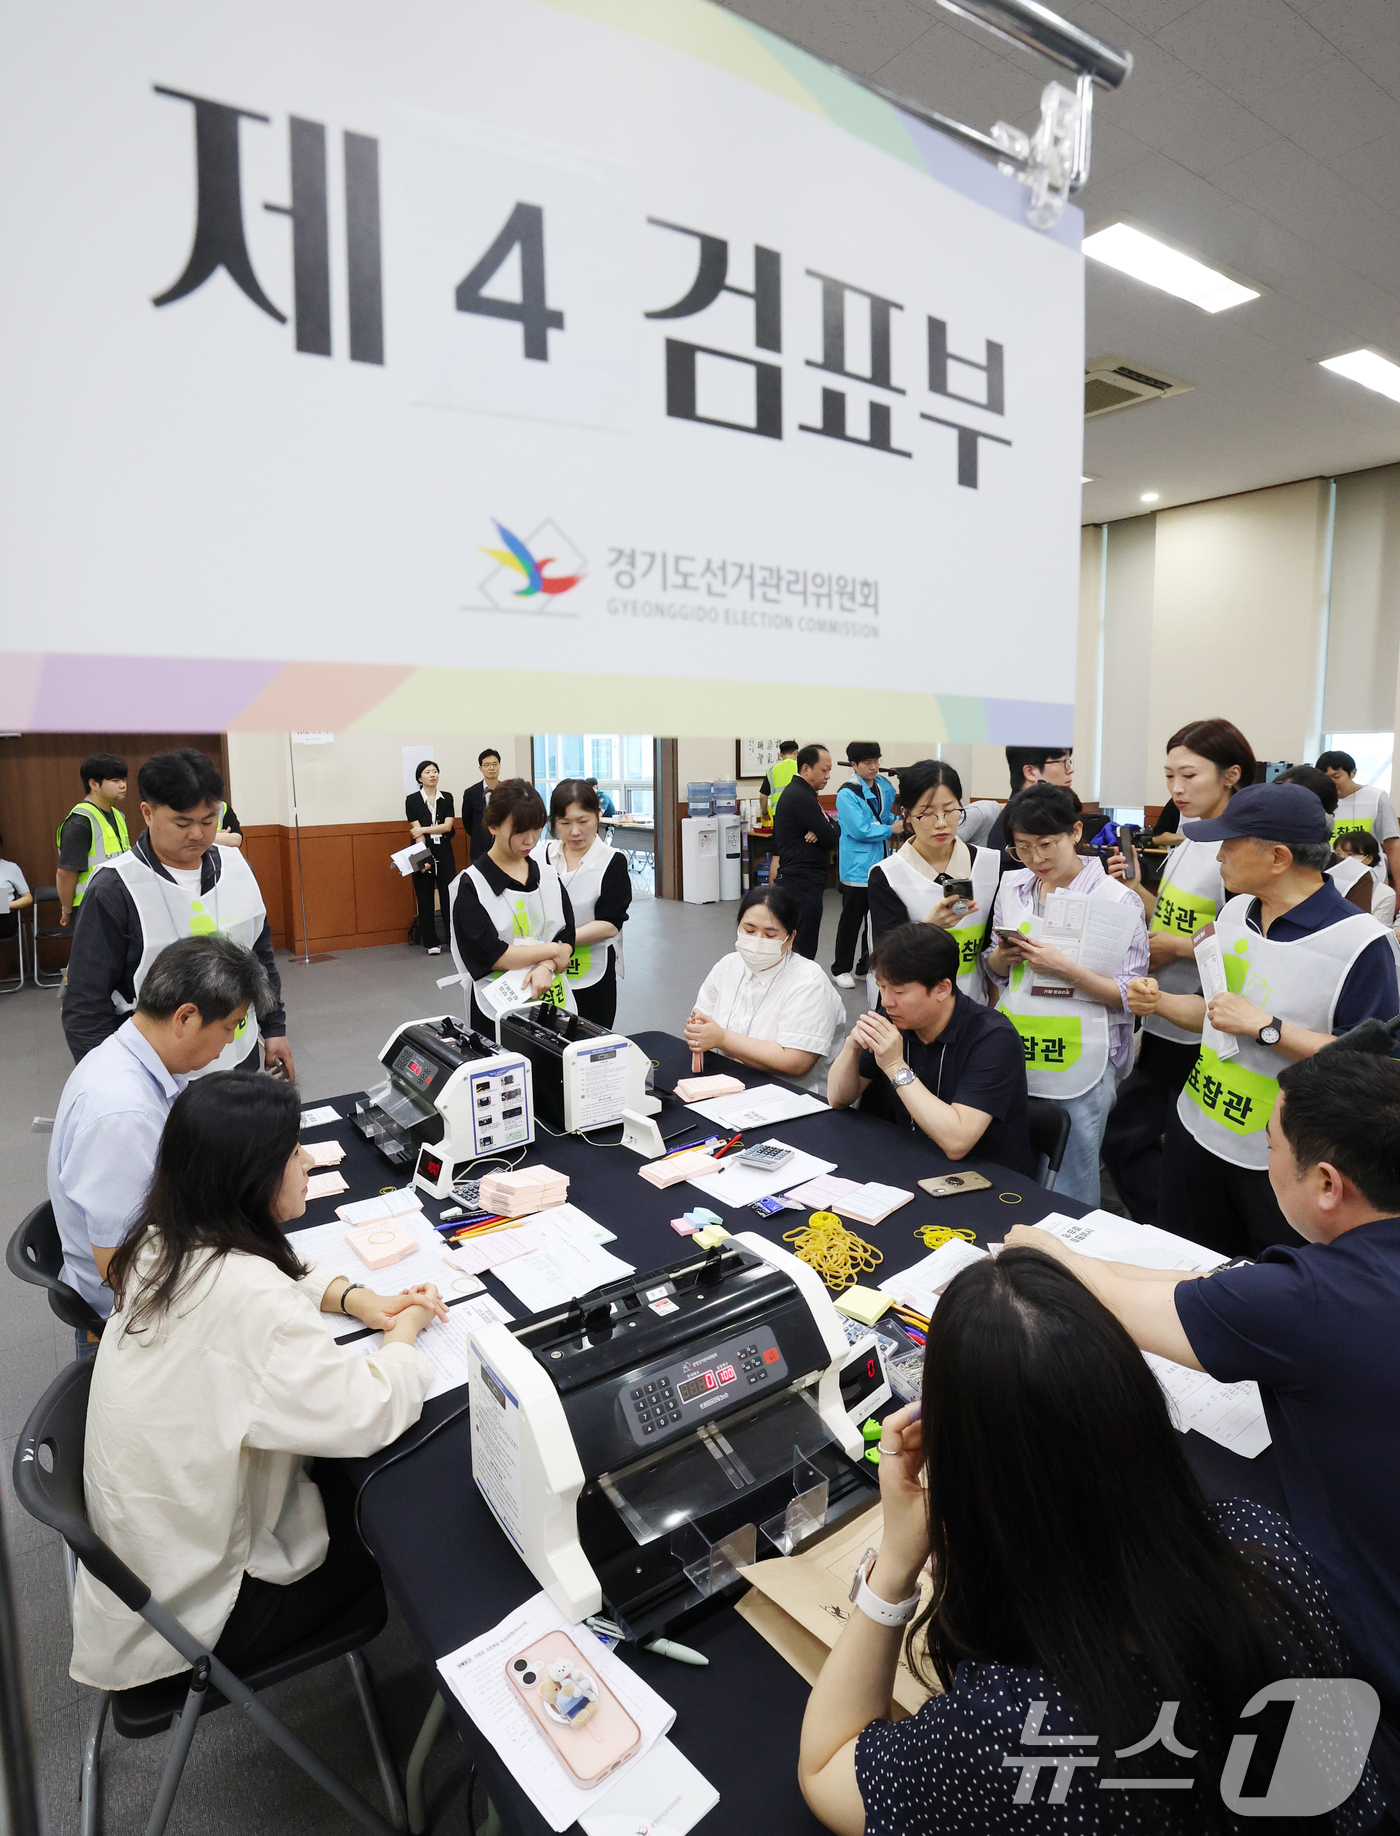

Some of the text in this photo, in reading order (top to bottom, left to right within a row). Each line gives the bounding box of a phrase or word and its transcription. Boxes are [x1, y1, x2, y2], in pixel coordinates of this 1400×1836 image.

[151, 82, 1013, 491] 제 4 검표부
[606, 546, 880, 616] 경기도선거관리위원회
[606, 597, 881, 640] GYEONGGIDO ELECTION COMMISSION
[427, 1161, 440, 1176] 100
[720, 1368, 734, 1381] 100
[867, 1359, 875, 1379] 0
[704, 1372, 715, 1389] 0
